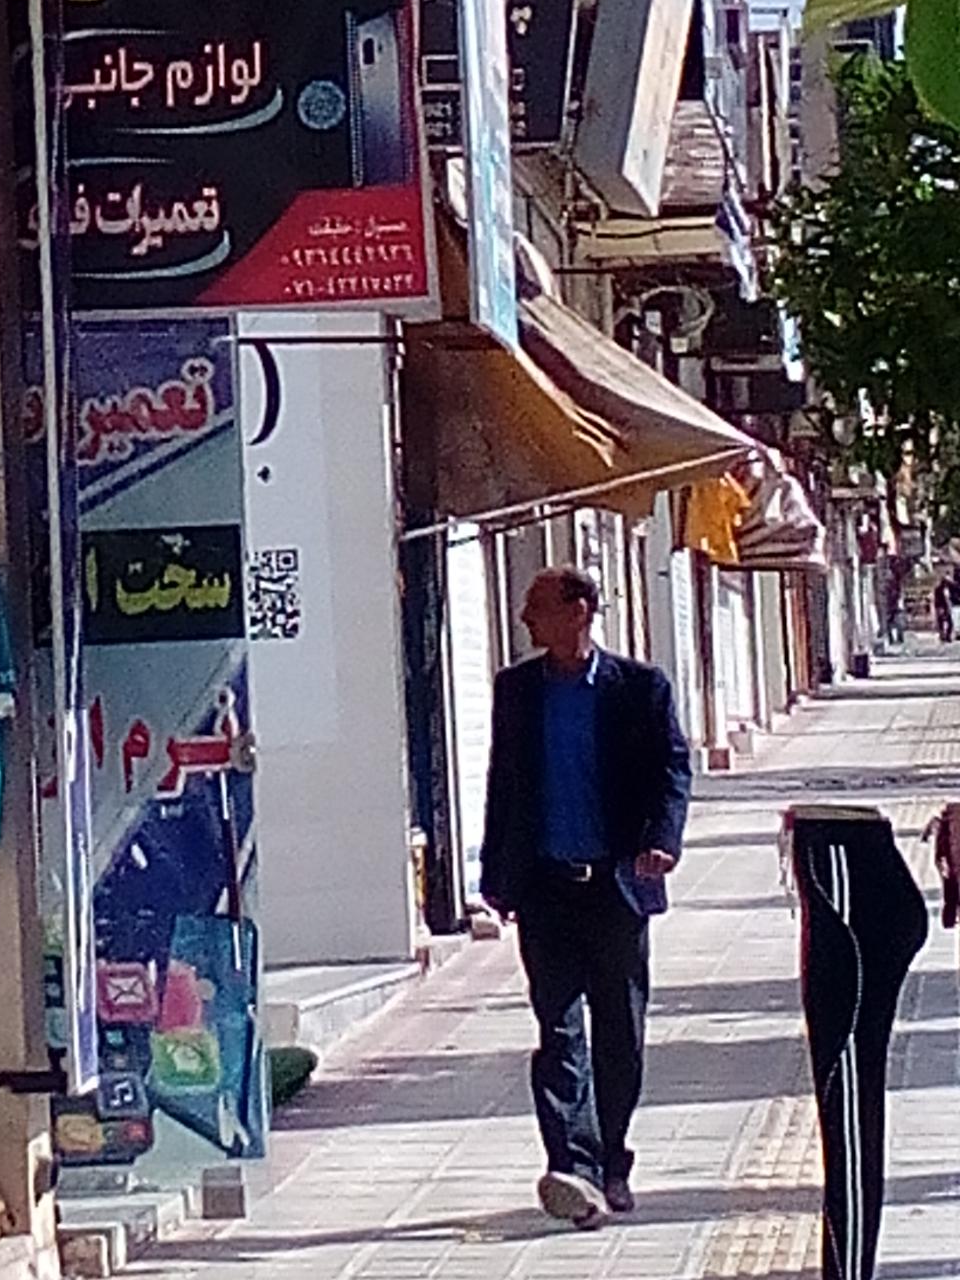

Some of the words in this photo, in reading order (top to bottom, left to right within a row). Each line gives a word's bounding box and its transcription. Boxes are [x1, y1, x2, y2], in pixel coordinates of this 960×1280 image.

[50, 46, 155, 111] جانب
[166, 40, 263, 108] لوازم
[95, 182, 221, 256] تعمیرات
[24, 357, 214, 465] تعمیر
